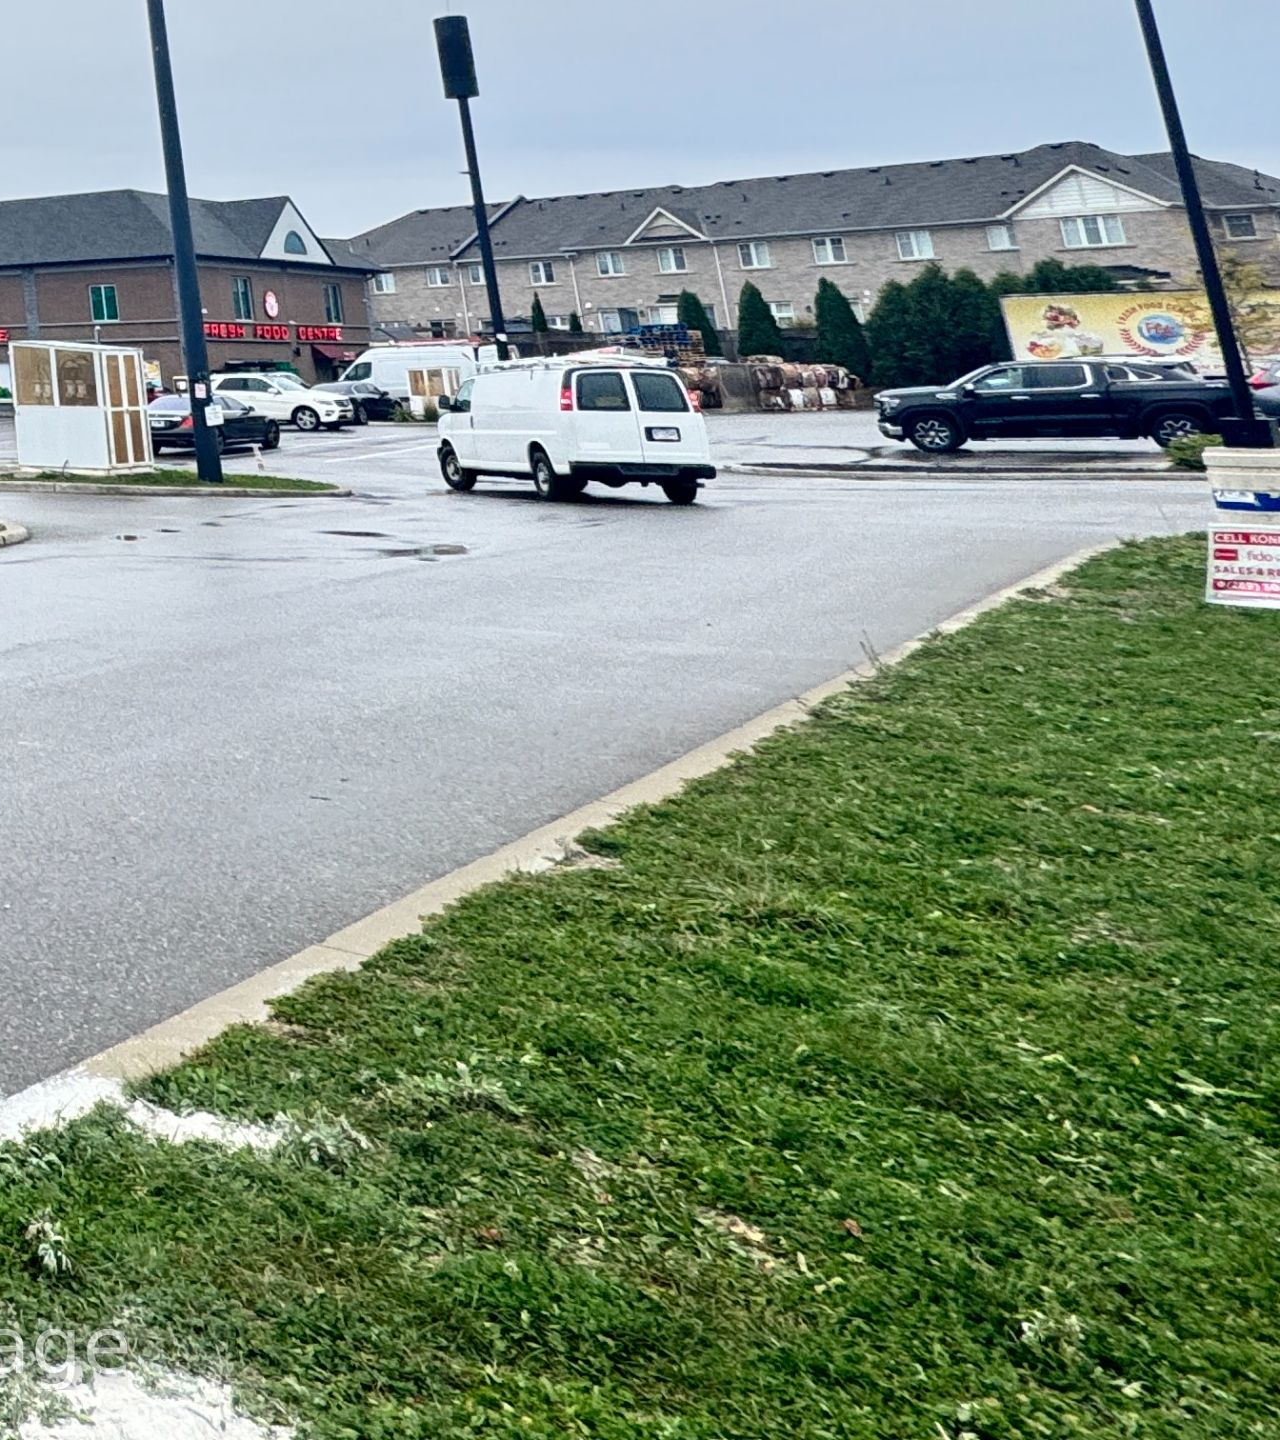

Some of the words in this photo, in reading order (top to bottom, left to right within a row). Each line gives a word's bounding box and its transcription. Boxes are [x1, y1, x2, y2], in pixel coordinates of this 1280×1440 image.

[255, 325, 289, 340] FOOD
[1215, 533, 1246, 543] CELL
[1214, 565, 1253, 574] SALES
